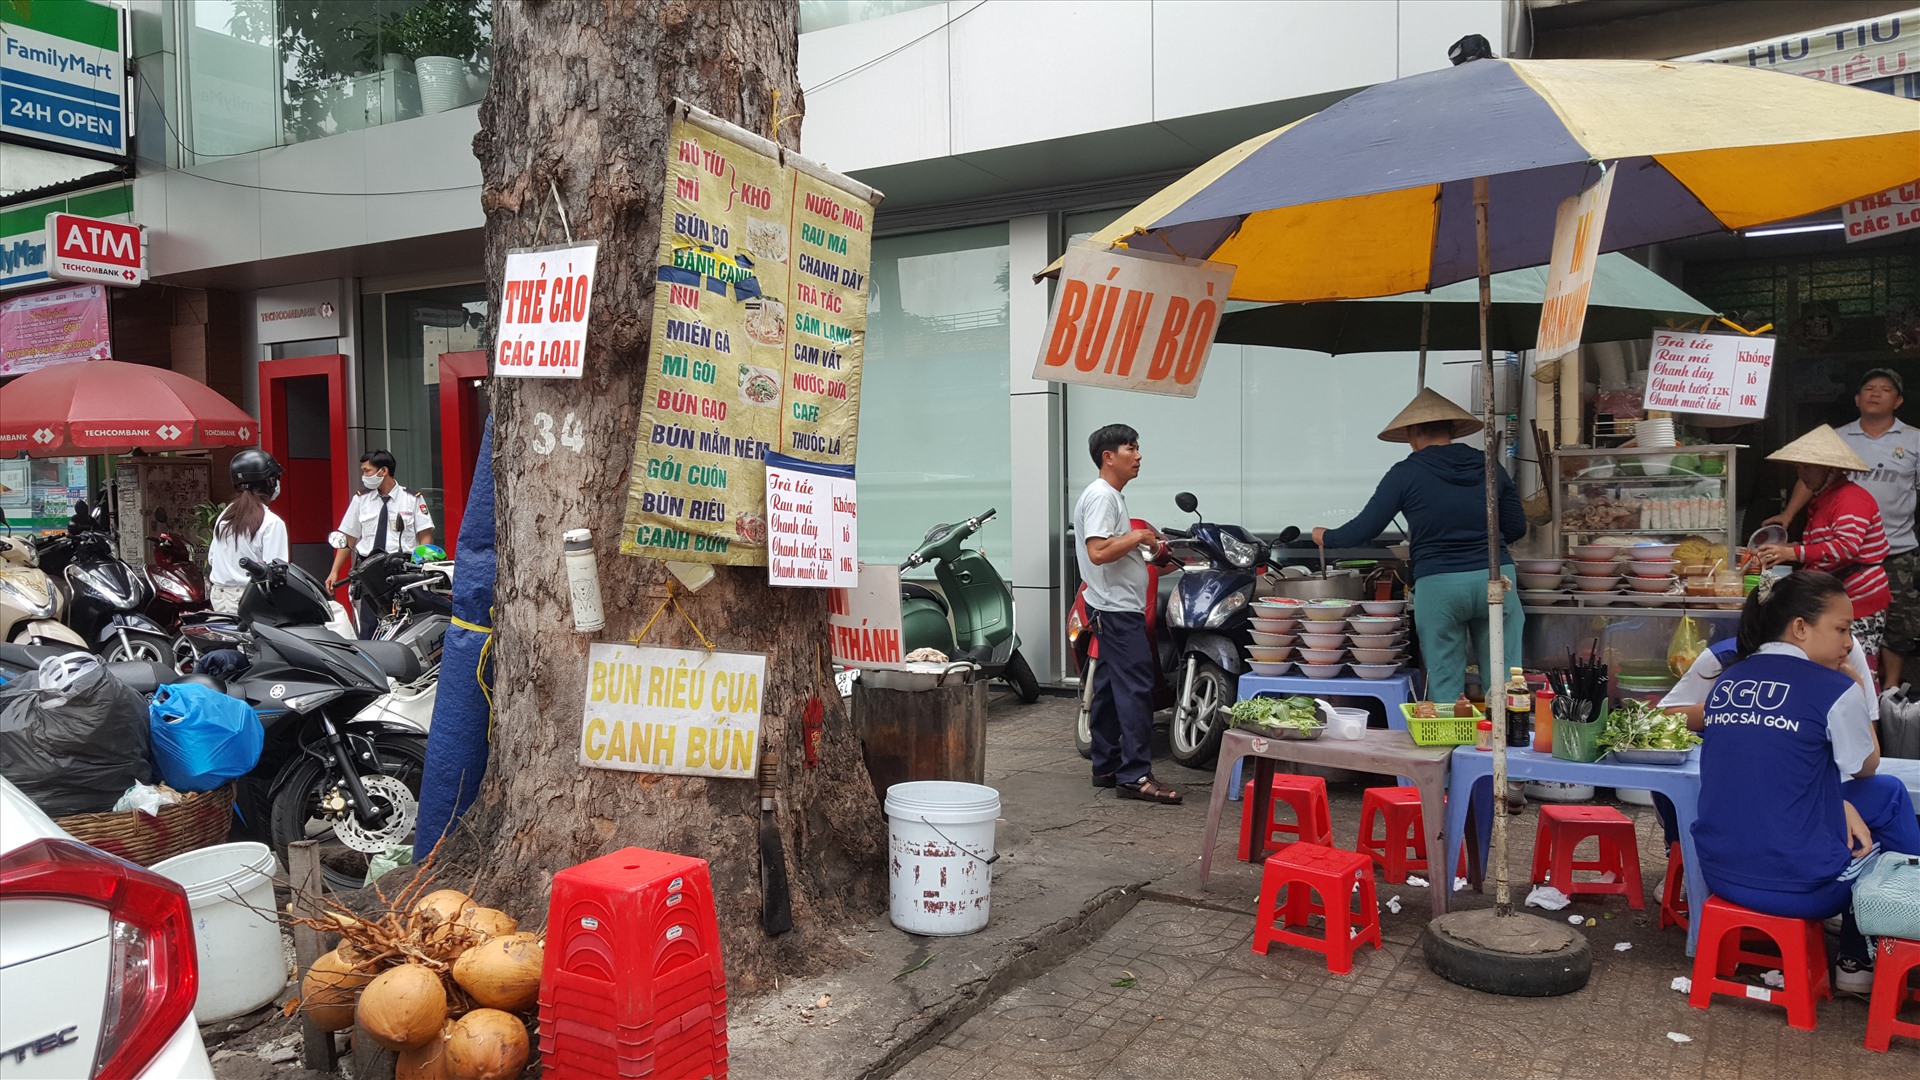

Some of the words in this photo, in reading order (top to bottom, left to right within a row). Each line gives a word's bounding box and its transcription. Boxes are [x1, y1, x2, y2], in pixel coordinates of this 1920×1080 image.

[7, 37, 112, 80] FamilyMart
[10, 98, 51, 123] 24H
[58, 110, 113, 136] OPEN
[679, 138, 700, 166] HỦ
[703, 149, 726, 177] TÍU
[677, 177, 699, 202] MÌ
[741, 183, 771, 210] KHÔ
[805, 192, 839, 221] NƯỚC
[842, 207, 863, 232] MÍA
[1849, 214, 1890, 236] CÁC
[63, 224, 135, 260] ATM
[675, 213, 709, 242] BÚN
[712, 224, 728, 248] BÒ
[802, 223, 825, 247] RAU
[827, 234, 847, 255] MÁ
[62, 263, 119, 276] TECHCOMBANK
[674, 247, 715, 277] BÁNH
[799, 253, 839, 282] CHANH
[841, 269, 864, 291] DÂY
[505, 262, 547, 323] THẺ
[549, 263, 588, 322] CÀO
[670, 284, 699, 309] NUI
[797, 283, 817, 306] TRÀ
[821, 288, 842, 313] TẮC
[261, 307, 316, 322] TECHCOMBANK
[1044, 267, 1154, 376] BÚN
[1147, 282, 1217, 385] BÒ
[715, 329, 731, 353] GÀ
[796, 312, 820, 336] SÂM
[823, 321, 853, 345] LẠNH
[500, 333, 535, 366] CÁC
[538, 340, 581, 374] LOẠI
[1655, 348, 1684, 362] Rau
[1688, 353, 1710, 364] má
[1656, 335, 1685, 349] Trà
[1689, 338, 1713, 350] tắc
[662, 353, 688, 378] MÌ
[693, 359, 716, 384] GÓI
[794, 343, 819, 365] CAM
[822, 346, 842, 370] VẮT
[1653, 361, 1689, 378] Chanh
[1691, 366, 1714, 382] dây
[1746, 370, 1757, 385] lồ
[793, 372, 824, 394] NƯỚC
[828, 378, 847, 400] DỪA
[1649, 391, 1682, 407] Chanh
[1651, 377, 1685, 393] Chanh
[1688, 382, 1710, 395] tươi
[1712, 387, 1730, 397] 12K
[657, 388, 697, 415] BÚN
[702, 398, 727, 423] GẠO
[793, 402, 819, 423] CAFE
[1739, 394, 1757, 406] 10K
[84, 429, 150, 437] TECHCOMBANK
[204, 429, 235, 437] TECHCOMBANK
[532, 412, 585, 455] 34
[651, 423, 695, 449] BÚN
[700, 427, 731, 455] MẮM
[734, 436, 770, 460] NÊM
[792, 429, 825, 453] THUỐC
[828, 435, 841, 455] LÁ
[647, 455, 682, 482] GỎI
[688, 462, 727, 488] CUỐN
[769, 473, 791, 492] Trà
[795, 479, 814, 495] tắc
[1853, 463, 1898, 483] win
[642, 491, 684, 517] BÚN
[689, 498, 725, 522] RIÊU
[770, 493, 794, 512] Rau
[796, 500, 813, 514] má
[636, 525, 689, 550] CANH
[694, 532, 731, 552] BÚN
[771, 512, 799, 535] Chanh
[801, 518, 818, 540] dây
[772, 536, 799, 558] Chanh
[801, 542, 817, 559] tươi
[819, 548, 832, 560] 12K
[772, 557, 796, 580] Chanh
[817, 560, 828, 580] tắc
[840, 557, 853, 572] 10K
[837, 618, 900, 663] THÁNH
[590, 650, 643, 705] BÚN
[648, 658, 706, 710] RIÊU
[711, 670, 759, 714] CUA
[1709, 679, 1791, 710] SGU
[1715, 712, 1739, 725] HỌC
[1739, 711, 1761, 725] SÀI
[1763, 715, 1799, 732] GÒN
[584, 717, 677, 767] CANH
[685, 716, 755, 772] BÚN
[0, 1024, 79, 1064] TEC
